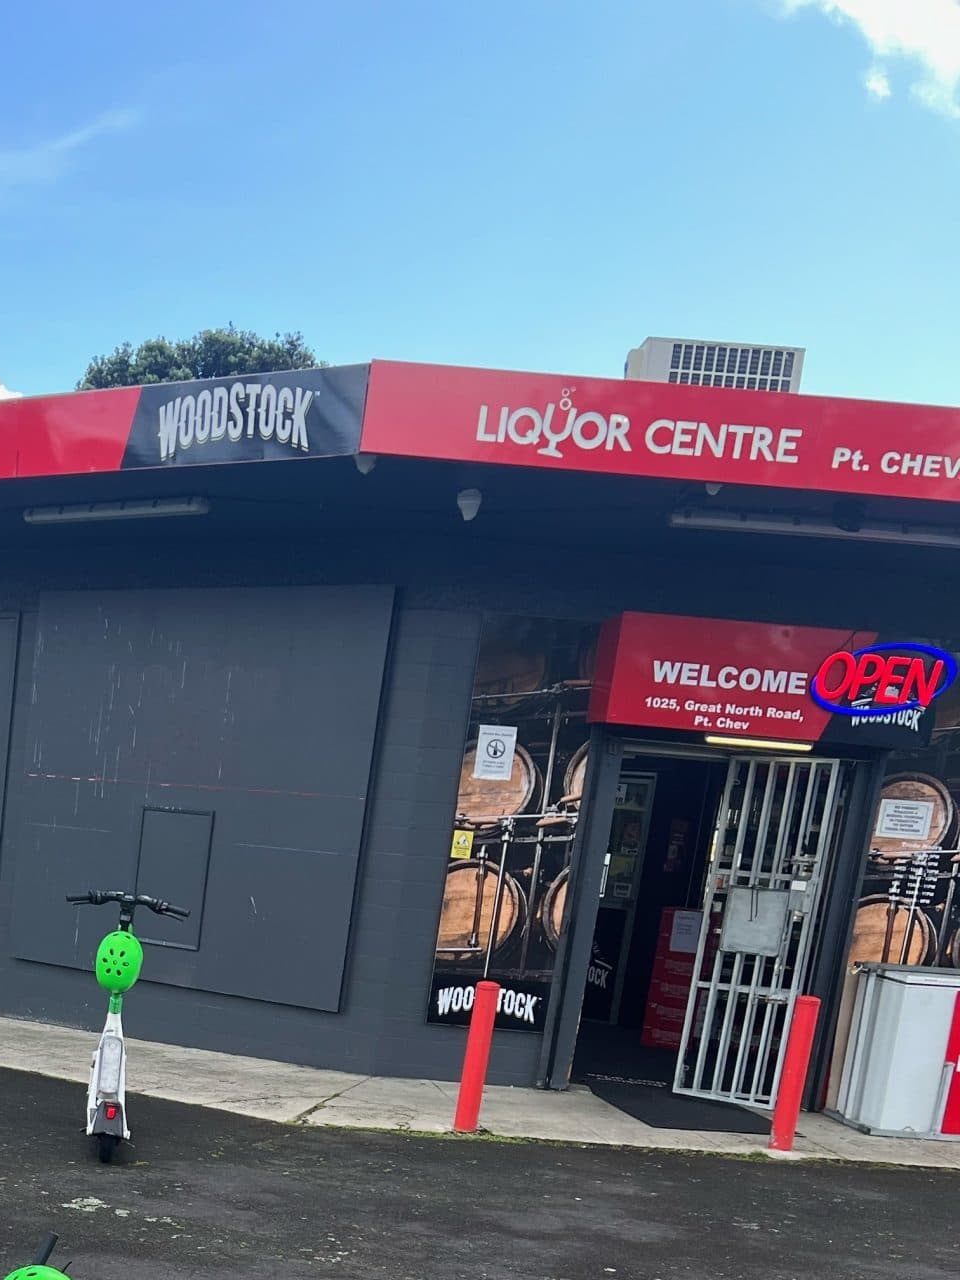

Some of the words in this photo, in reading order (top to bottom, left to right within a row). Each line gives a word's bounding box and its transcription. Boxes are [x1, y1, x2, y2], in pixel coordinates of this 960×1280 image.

[158, 382, 313, 462] WOODSTOCK
[475, 403, 632, 458] LIQUOR
[645, 419, 803, 463] CENTRE
[832, 447, 869, 472] Pt.
[881, 452, 960, 479] CHEV
[653, 660, 809, 695] WELCOME
[816, 651, 944, 708] OPEN
[645, 697, 680, 711] 1025,
[685, 700, 724, 713] Great
[726, 703, 763, 717] North
[766, 708, 803, 723] Road,
[694, 716, 712, 727] Pt.
[715, 717, 750, 730] Chev
[437, 985, 538, 1025] WOOTOCK
